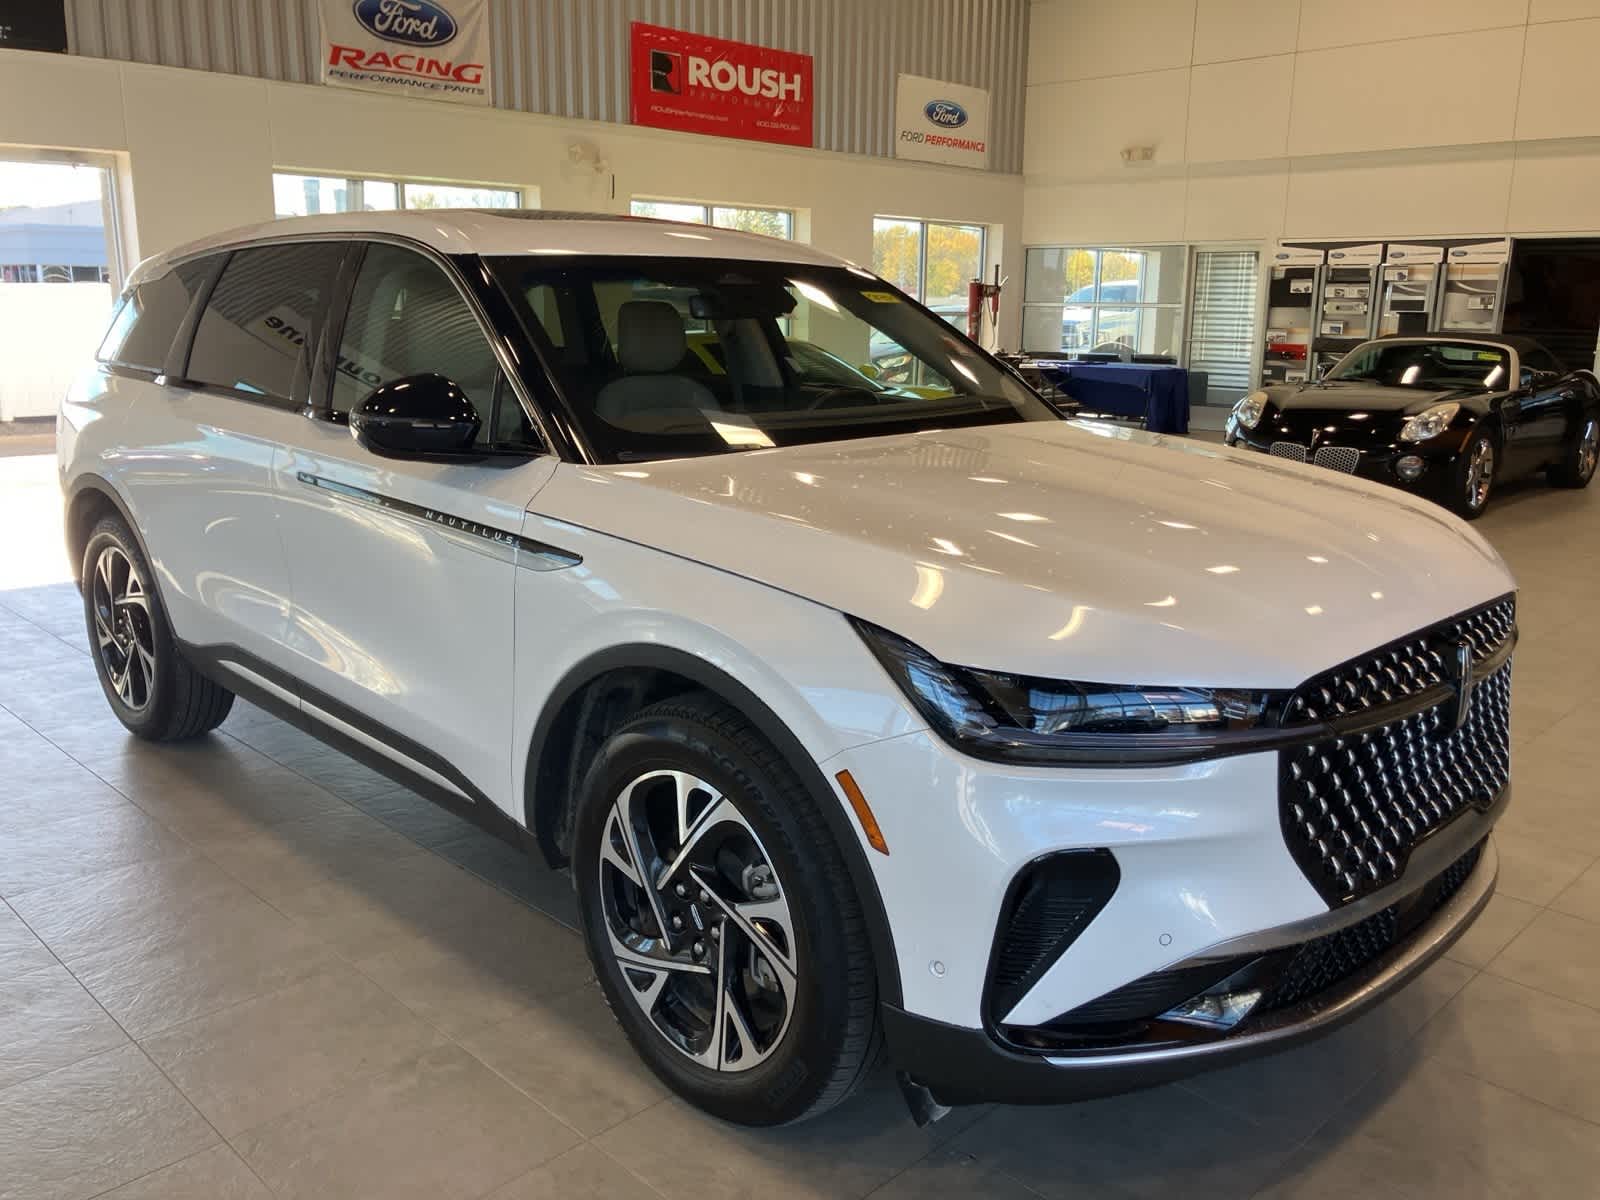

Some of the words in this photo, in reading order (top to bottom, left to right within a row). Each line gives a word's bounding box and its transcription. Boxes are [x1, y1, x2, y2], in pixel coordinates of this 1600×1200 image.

[374, 0, 439, 40] Ford
[329, 43, 484, 84] RACING
[688, 56, 802, 102] ROUSH
[329, 69, 440, 90] PERFORMANCE
[443, 84, 485, 95] PARTS
[932, 104, 960, 124] Ford
[900, 130, 924, 144] FORD
[925, 134, 985, 152] PERFORMANCE
[425, 511, 514, 545] NAUTILUS
